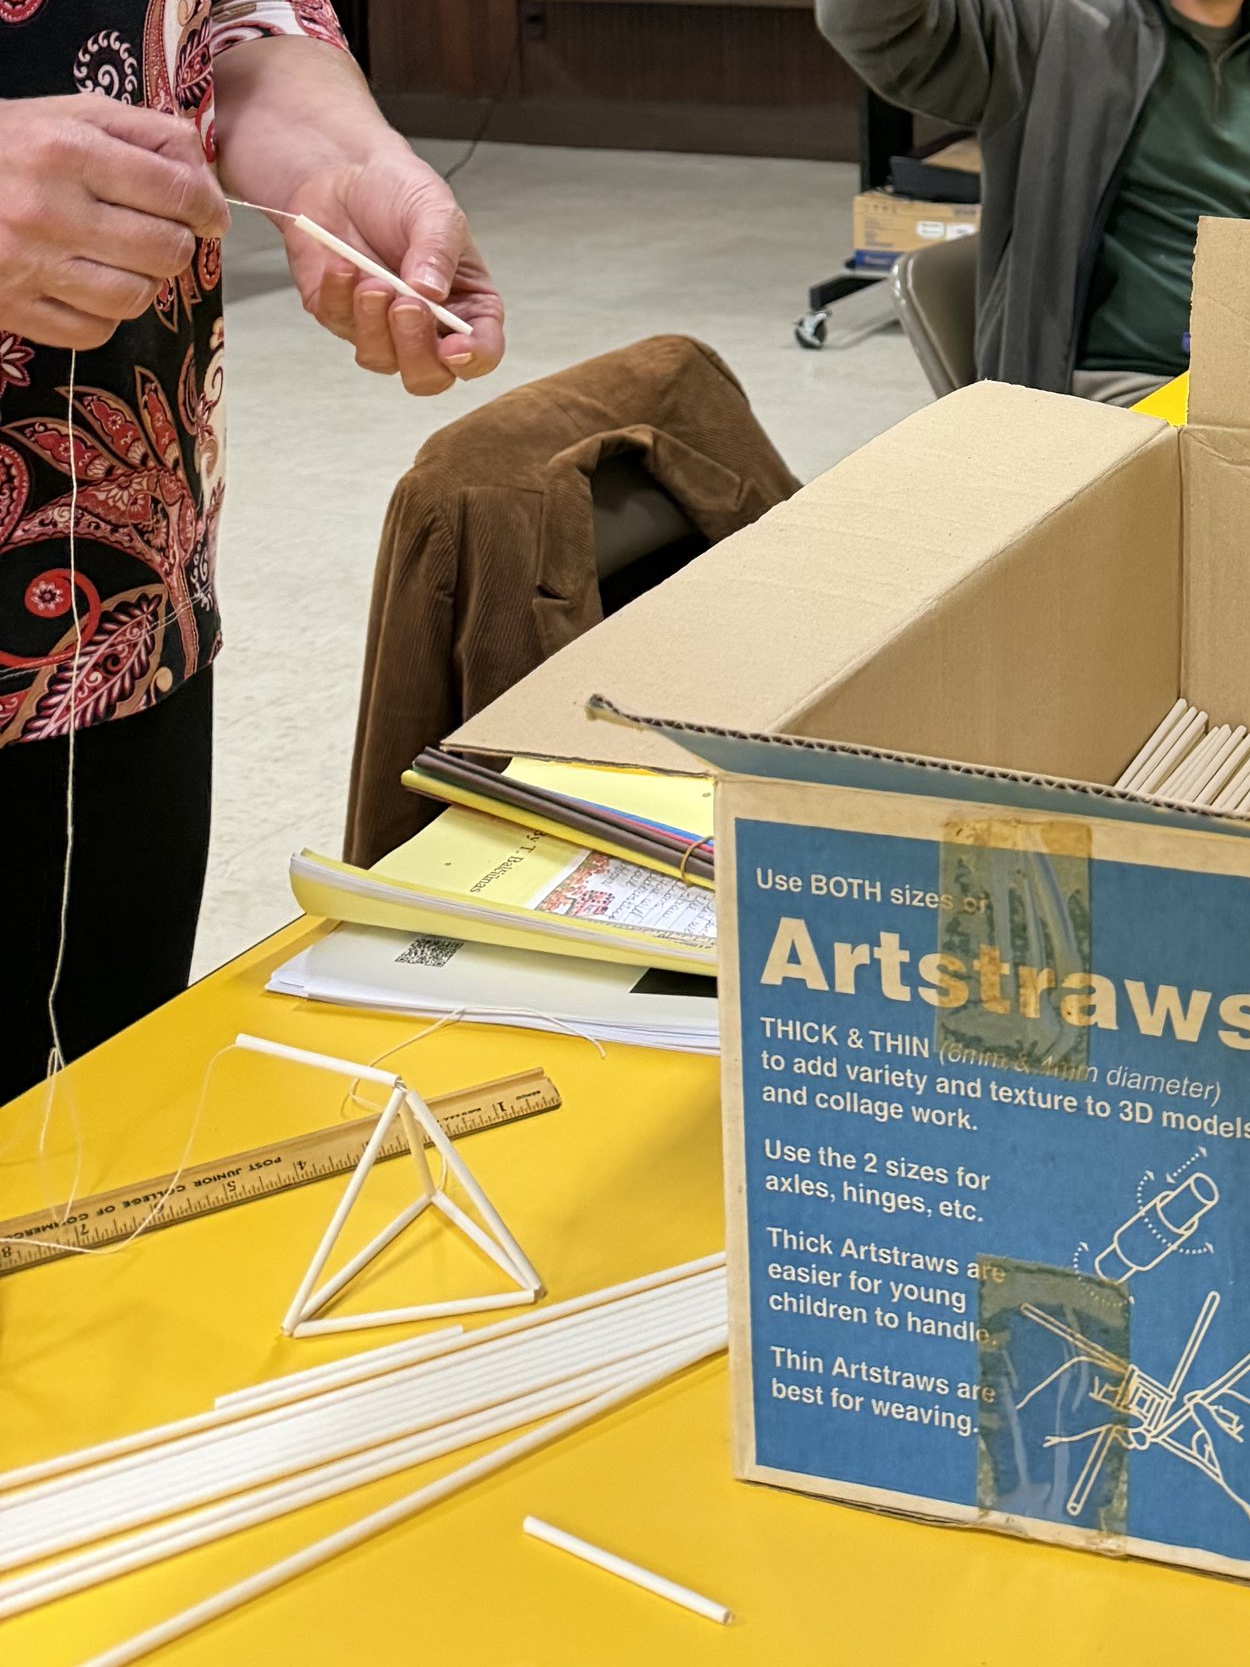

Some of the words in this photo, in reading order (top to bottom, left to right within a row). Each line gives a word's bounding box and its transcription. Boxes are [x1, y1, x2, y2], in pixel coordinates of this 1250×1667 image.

[756, 867, 802, 892] Use
[811, 874, 881, 902] BOTH
[890, 885, 954, 910] sizes
[760, 1017, 838, 1046] THICK
[847, 1029, 864, 1049] &
[869, 1030, 929, 1058] THIN
[1106, 1065, 1222, 1108] diameter)
[761, 1050, 785, 1071] to
[793, 1056, 838, 1078] add
[846, 1064, 928, 1095] variety
[936, 1078, 982, 1098] and
[990, 1080, 1079, 1113] texture
[1085, 1095, 1111, 1118] to
[1118, 1100, 1153, 1124] 3D
[762, 1085, 808, 1106] and
[815, 1092, 904, 1123] collage
[911, 1106, 978, 1131] work.
[193, 1168, 242, 1188] JUNIOR
[249, 1156, 282, 1173] POST
[764, 1138, 811, 1164] Use
[818, 1146, 856, 1170] the
[863, 1153, 878, 1173] 2
[885, 1157, 949, 1184] sizes
[956, 1166, 991, 1191] for
[96, 1203, 116, 1218] OF
[121, 1184, 186, 1210] COLLEGE
[765, 1174, 837, 1203] axles,
[842, 1181, 933, 1218] hinges,
[939, 1200, 984, 1222] etc.
[0, 1212, 89, 1241] COMERC
[766, 1227, 833, 1255] Thick
[840, 1238, 959, 1276] Artstraws
[966, 1262, 1006, 1284] are
[768, 1262, 842, 1288] easier
[849, 1270, 882, 1295] for
[889, 1281, 966, 1314] young
[768, 1292, 867, 1324] children
[875, 1307, 899, 1329] to
[907, 1311, 998, 1345] handle.
[770, 1345, 824, 1374] Thin
[832, 1356, 949, 1395] Artstraws
[957, 1381, 996, 1403] are
[771, 1378, 824, 1405] best
[830, 1387, 864, 1412] for
[871, 1398, 979, 1437] weaving.
